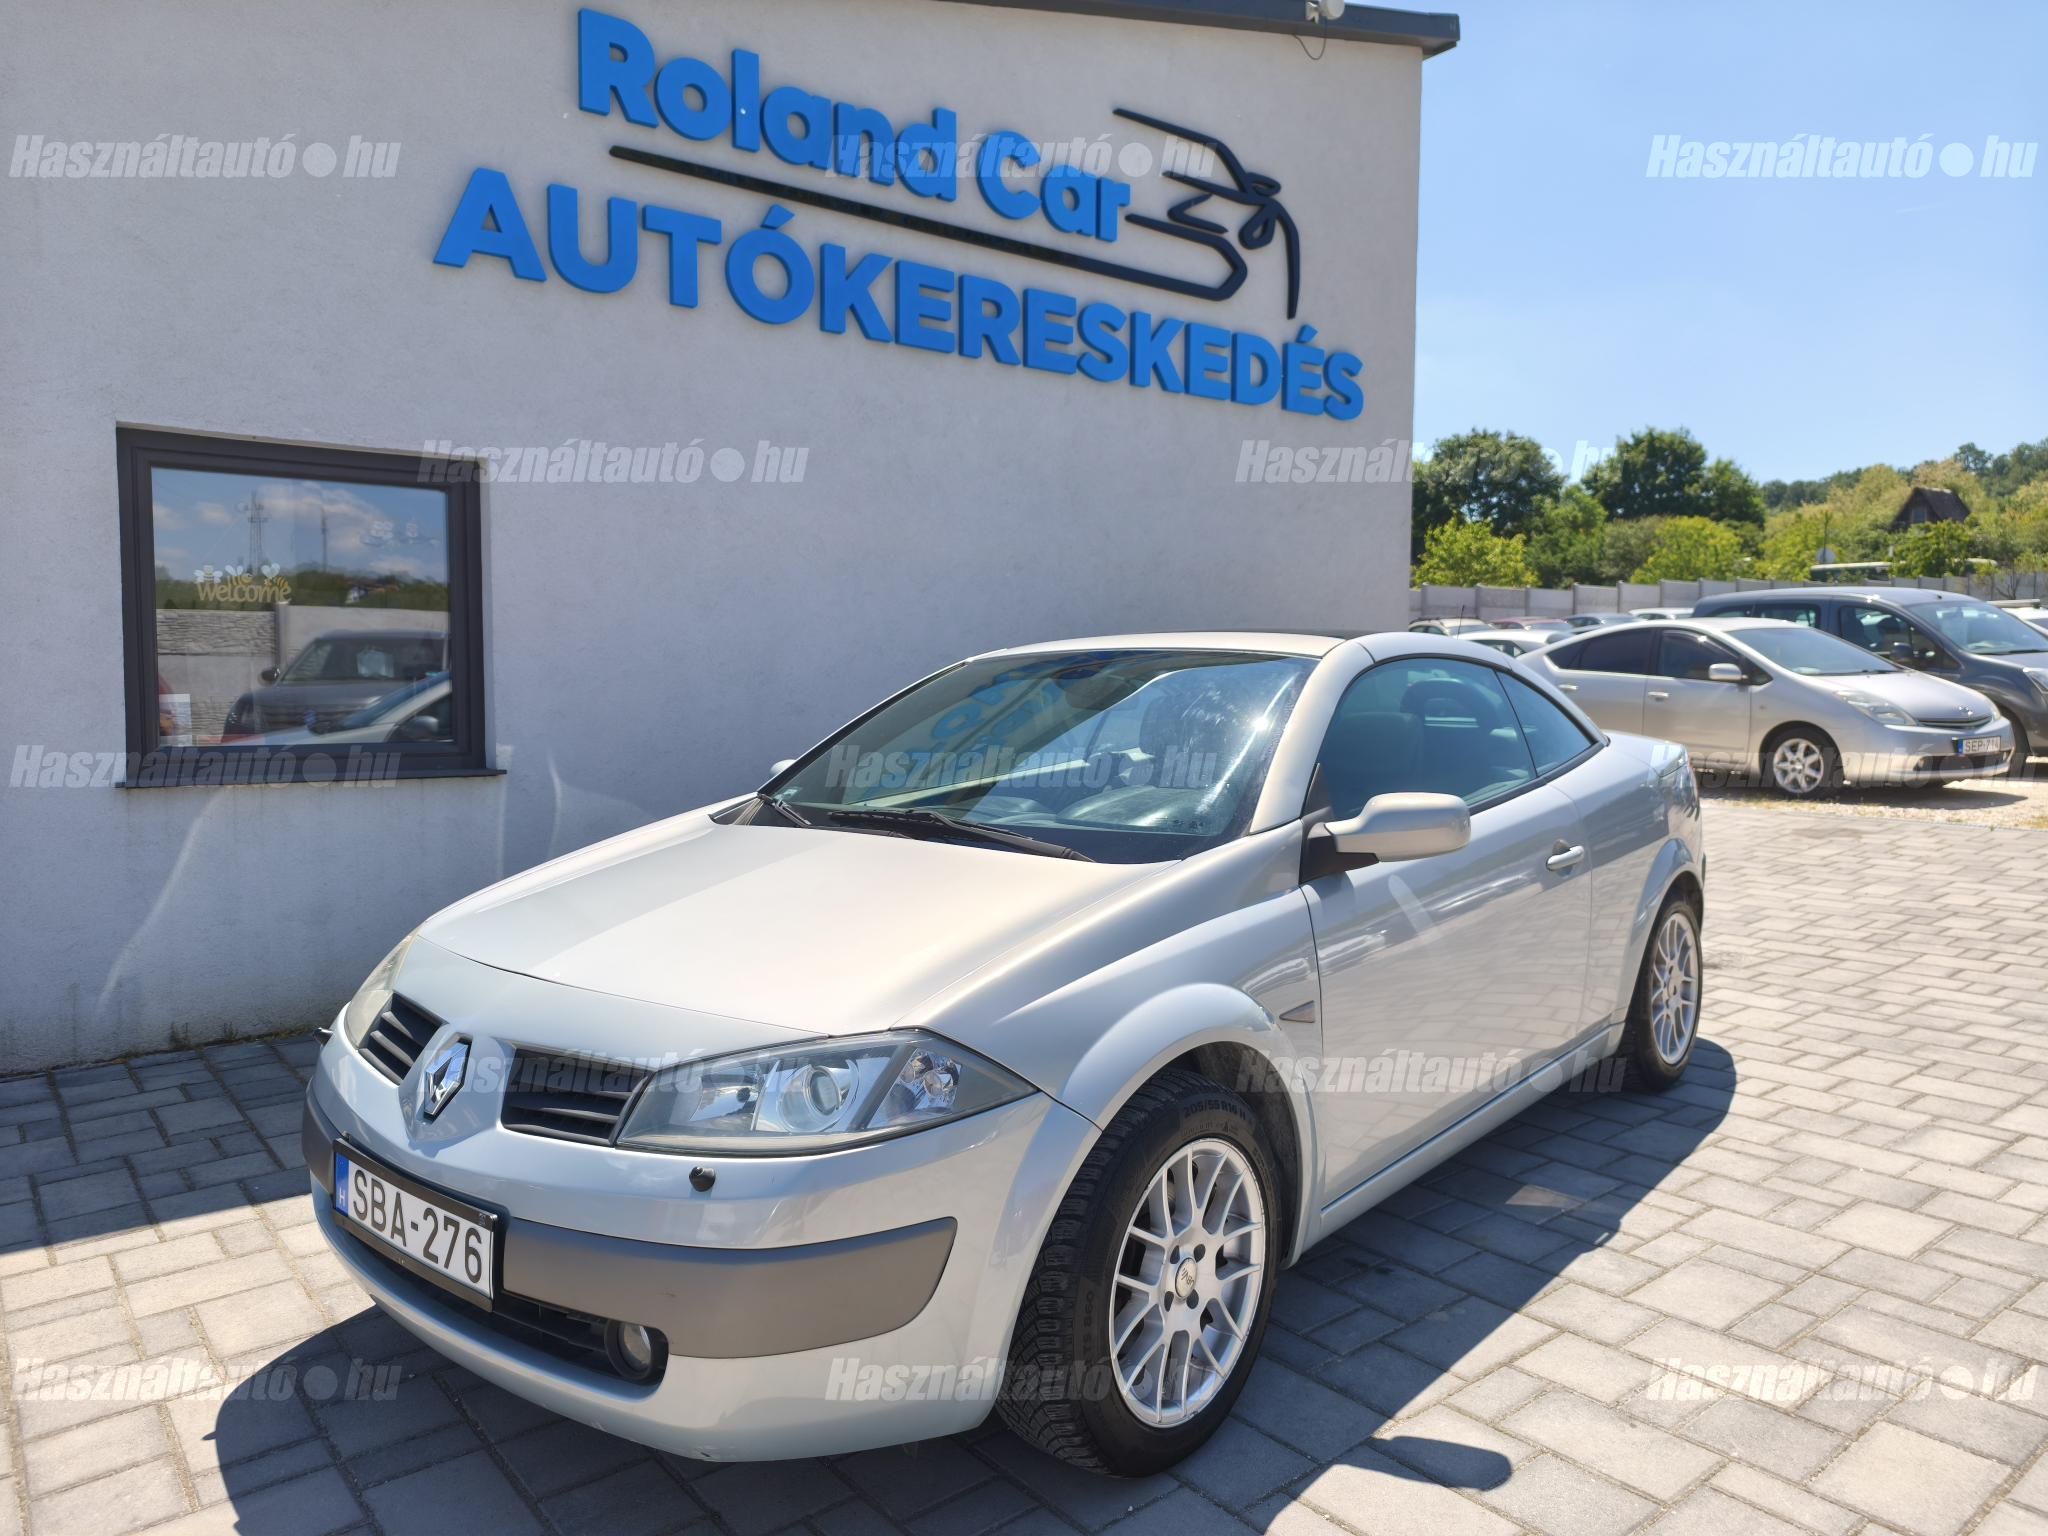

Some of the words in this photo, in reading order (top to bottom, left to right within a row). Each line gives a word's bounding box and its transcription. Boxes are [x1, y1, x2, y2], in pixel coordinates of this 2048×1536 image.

[578, 8, 956, 201] Roland
[976, 131, 1130, 242] Car
[433, 166, 1364, 422] AUTÓKERESKEDÉS
[352, 1169, 482, 1284] SBA-276
